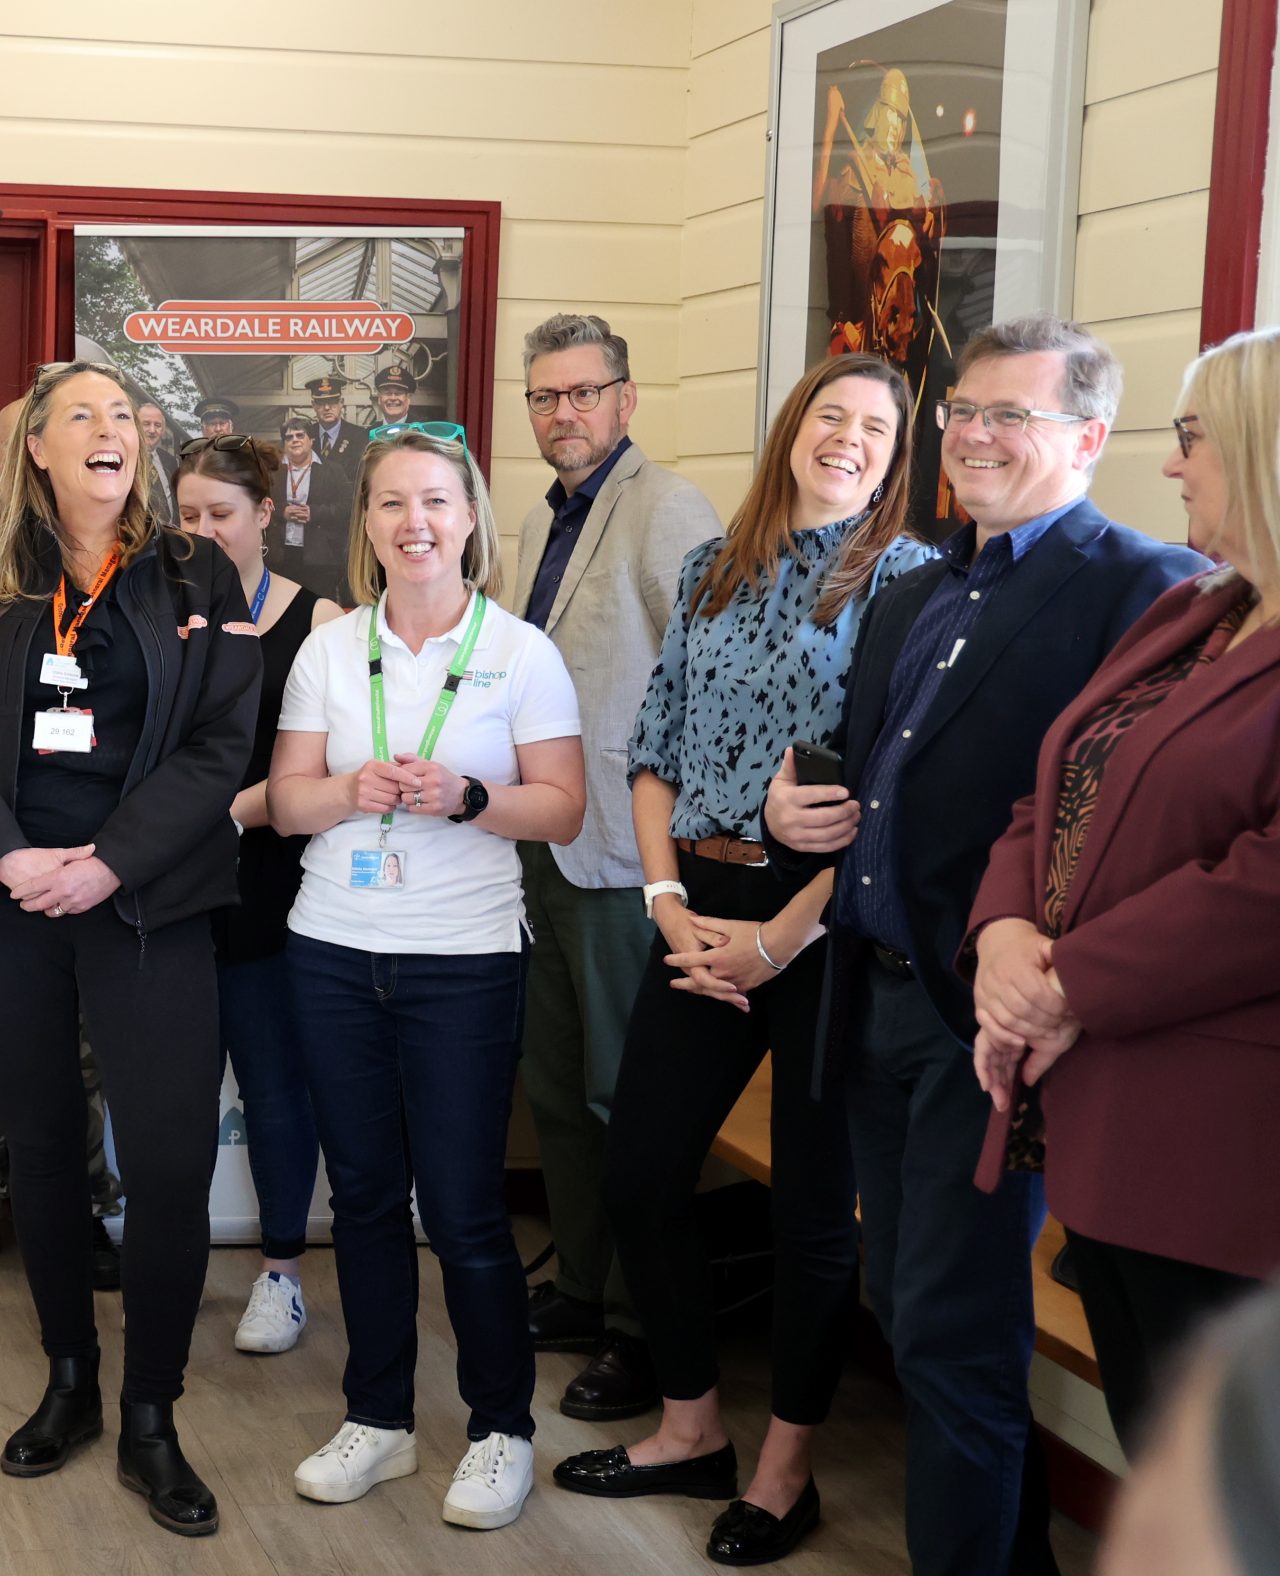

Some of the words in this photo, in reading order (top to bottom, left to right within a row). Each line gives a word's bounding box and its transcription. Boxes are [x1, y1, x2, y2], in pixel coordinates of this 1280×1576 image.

[138, 317, 281, 338] WEARDALE
[289, 317, 402, 338] RAILWAY
[474, 670, 507, 681] bishop
[472, 679, 492, 688] line
